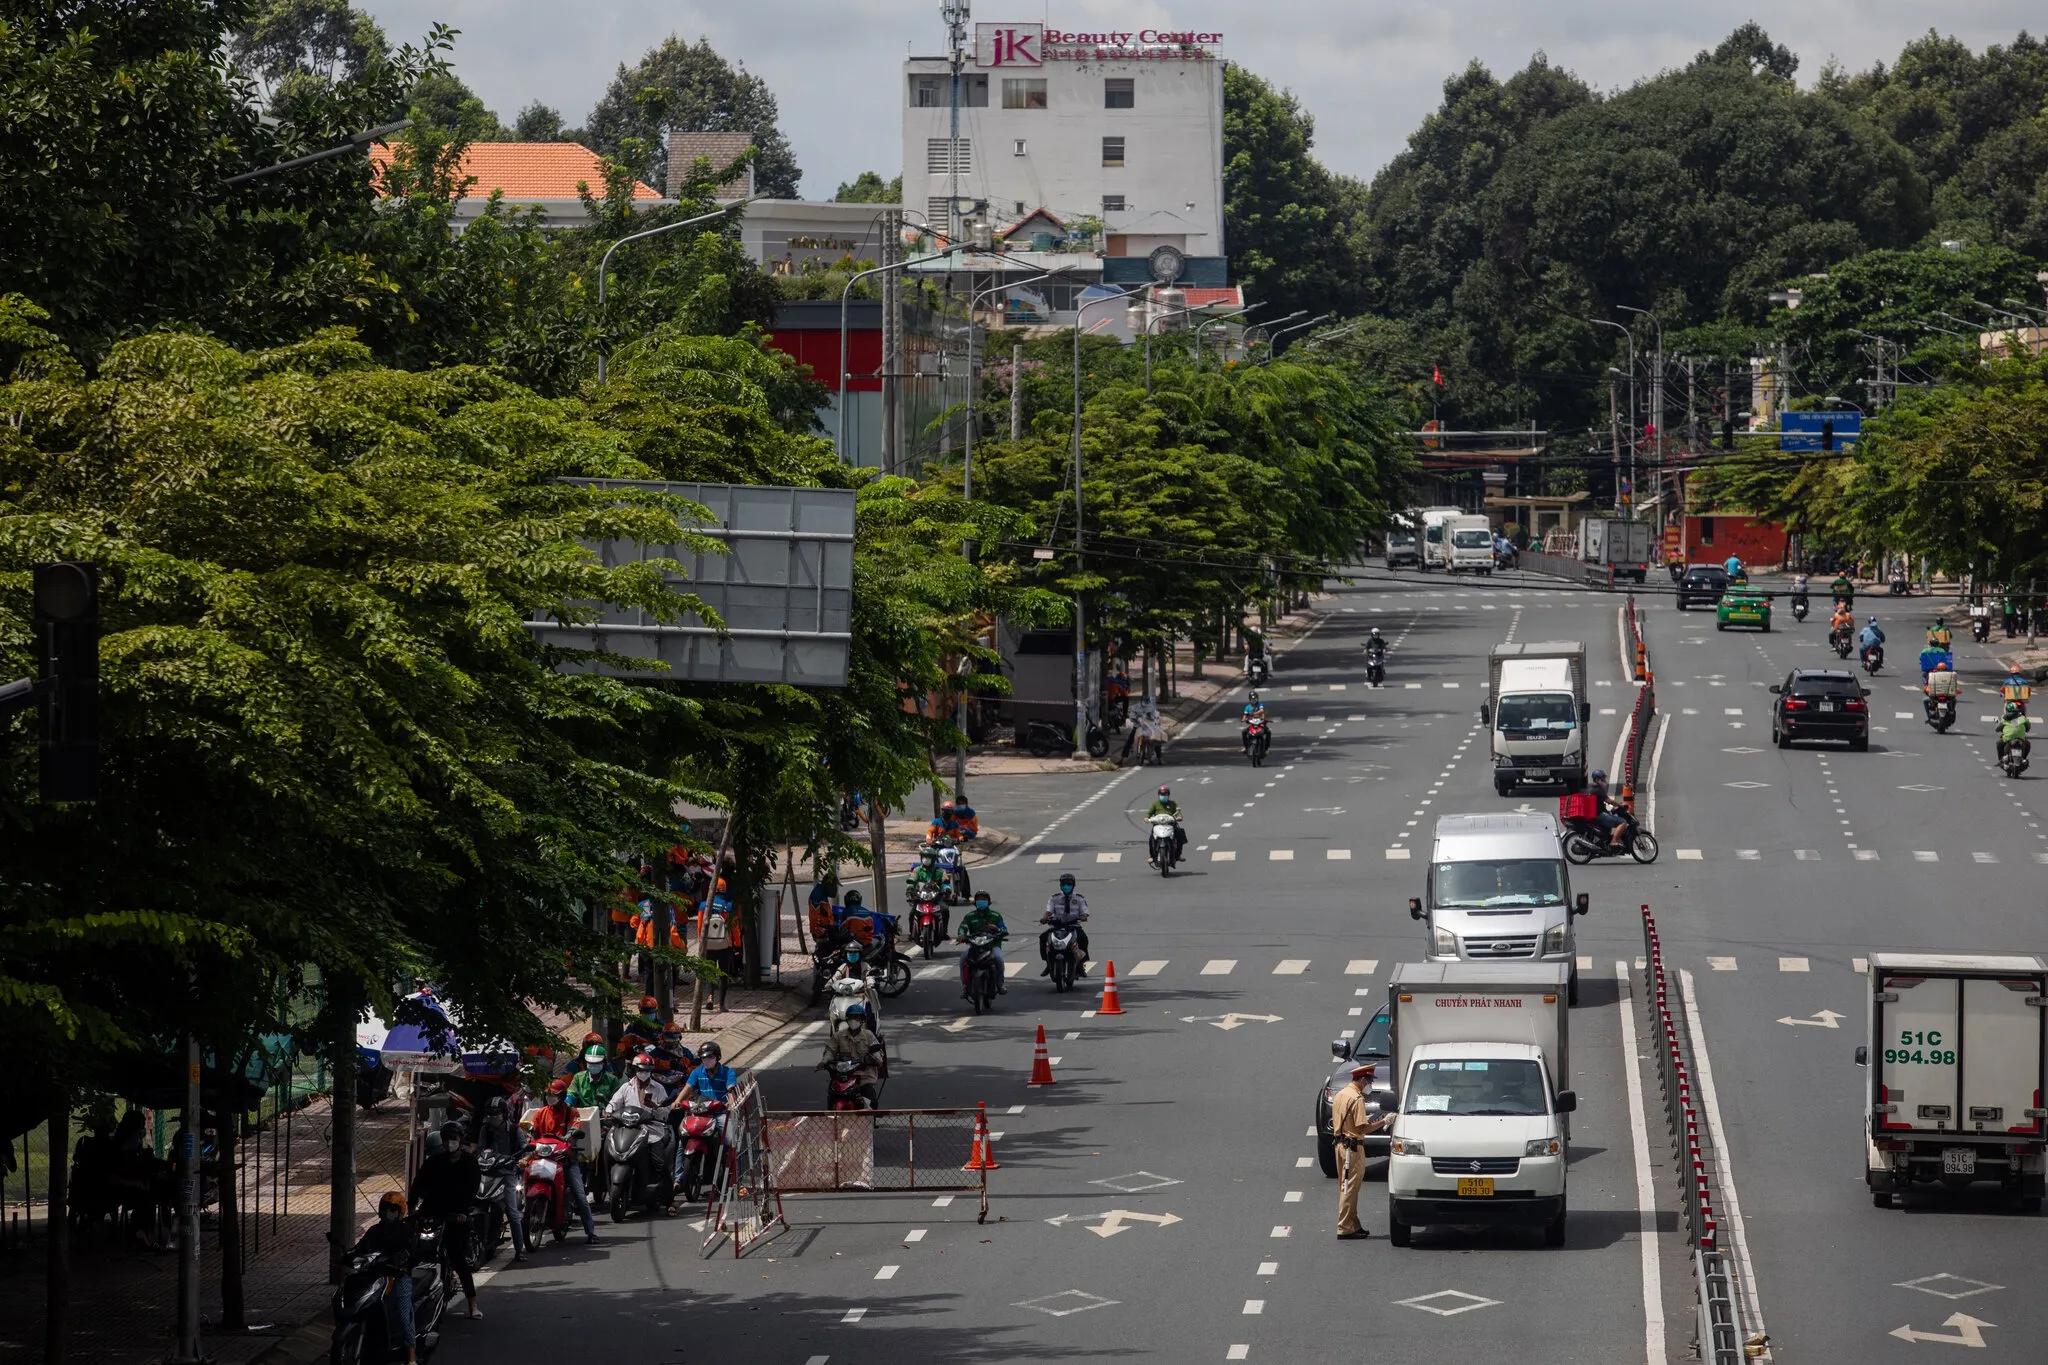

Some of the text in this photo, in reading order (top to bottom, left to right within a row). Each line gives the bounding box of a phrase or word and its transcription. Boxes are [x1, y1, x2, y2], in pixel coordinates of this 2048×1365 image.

[1044, 29, 1223, 48] Beauty Center
[1435, 994, 1522, 1007] CHUYỂN PHÁT NHANH
[1901, 1031, 1942, 1046] 51C
[1885, 1049, 1955, 1065] 994.98
[1952, 1154, 1967, 1163] 51C
[1946, 1163, 1973, 1172] 994.98
